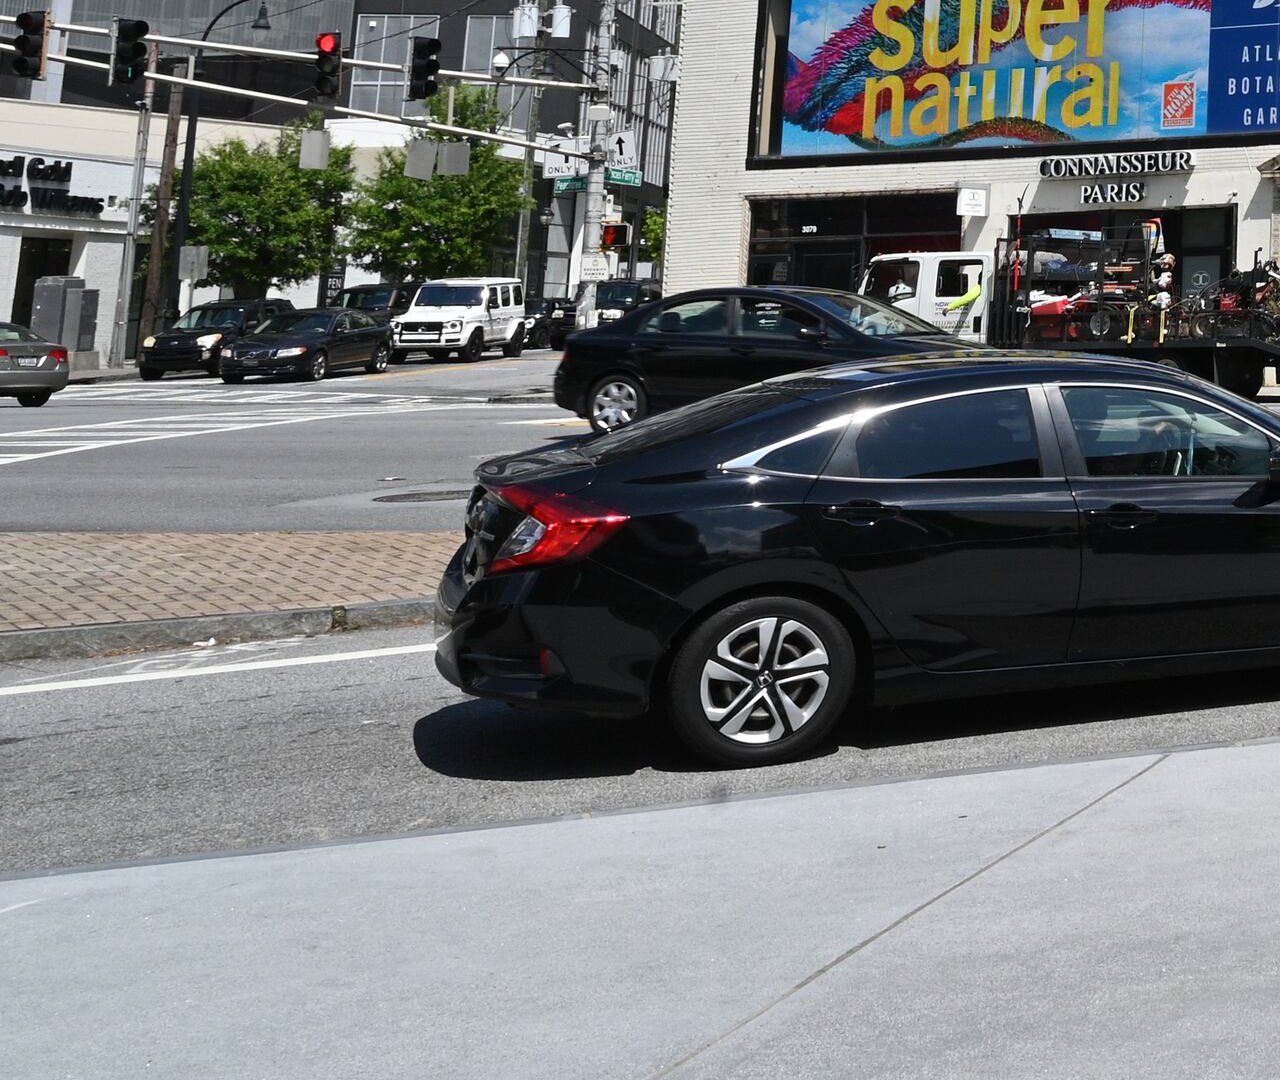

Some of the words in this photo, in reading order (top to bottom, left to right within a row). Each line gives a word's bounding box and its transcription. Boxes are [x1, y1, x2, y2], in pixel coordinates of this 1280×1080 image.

[861, 60, 1120, 141] natural
[611, 156, 634, 167] ONLY
[1038, 150, 1192, 178] CONNAISSEUR
[547, 165, 573, 175] ONLY
[1080, 182, 1143, 204] PARIS
[801, 225, 818, 233] 3079
